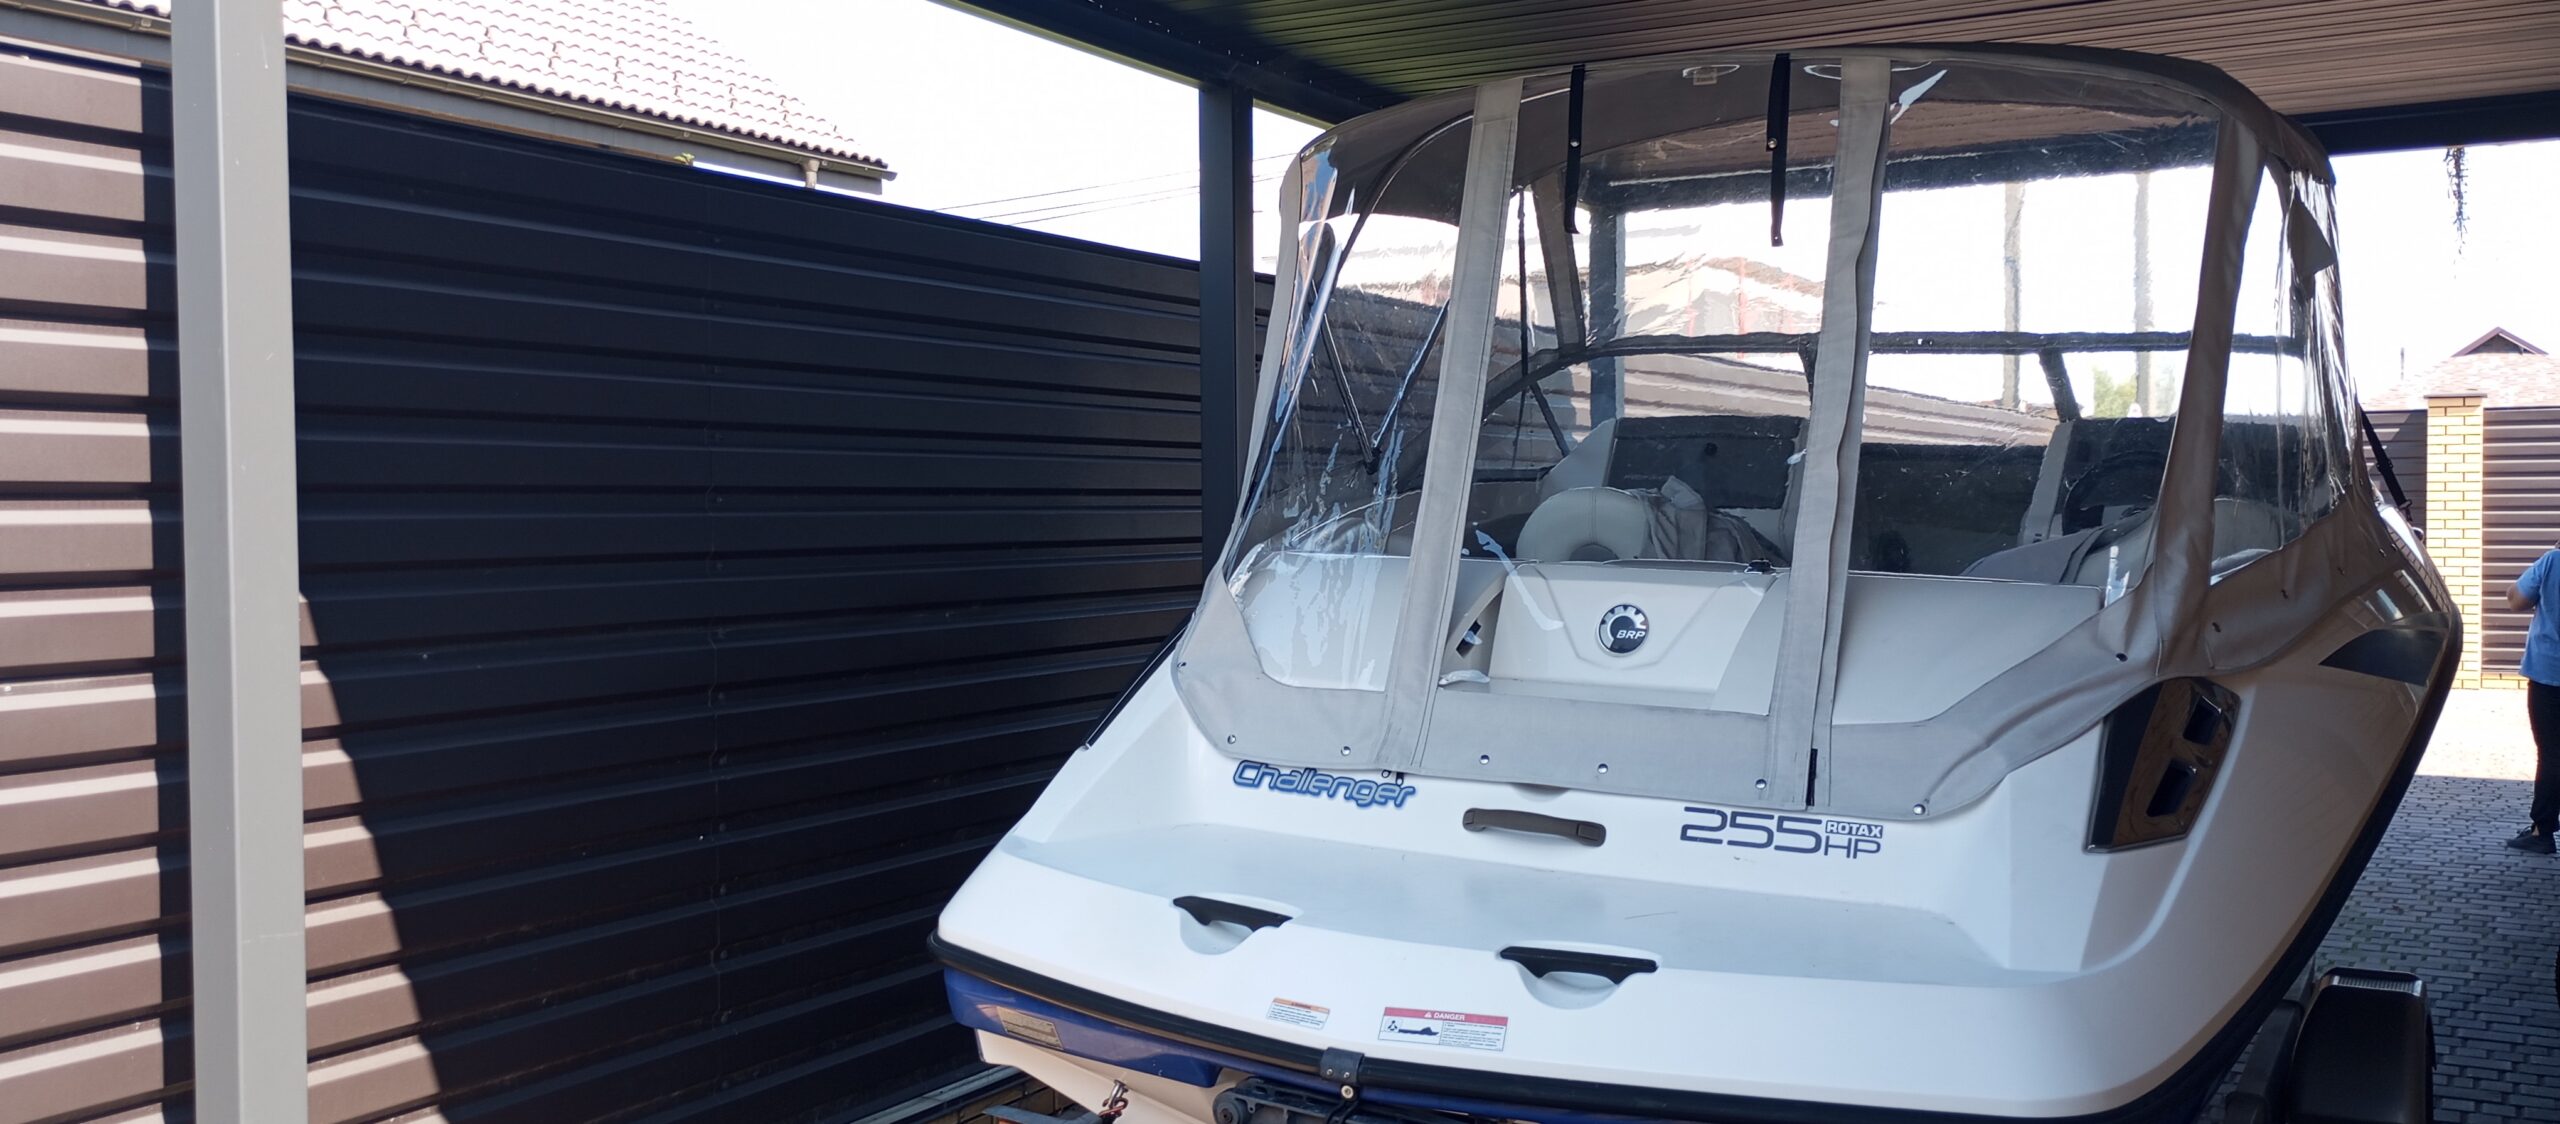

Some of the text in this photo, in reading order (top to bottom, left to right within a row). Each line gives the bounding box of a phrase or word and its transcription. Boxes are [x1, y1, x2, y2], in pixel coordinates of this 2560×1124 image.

[1616, 629, 1646, 640] BRP
[1233, 759, 1416, 808] Challenger
[1680, 806, 1823, 854] 255
[1825, 820, 1883, 838] ROTAX
[1823, 835, 1882, 859] HP
[1433, 1011, 1466, 1021] DANGER
